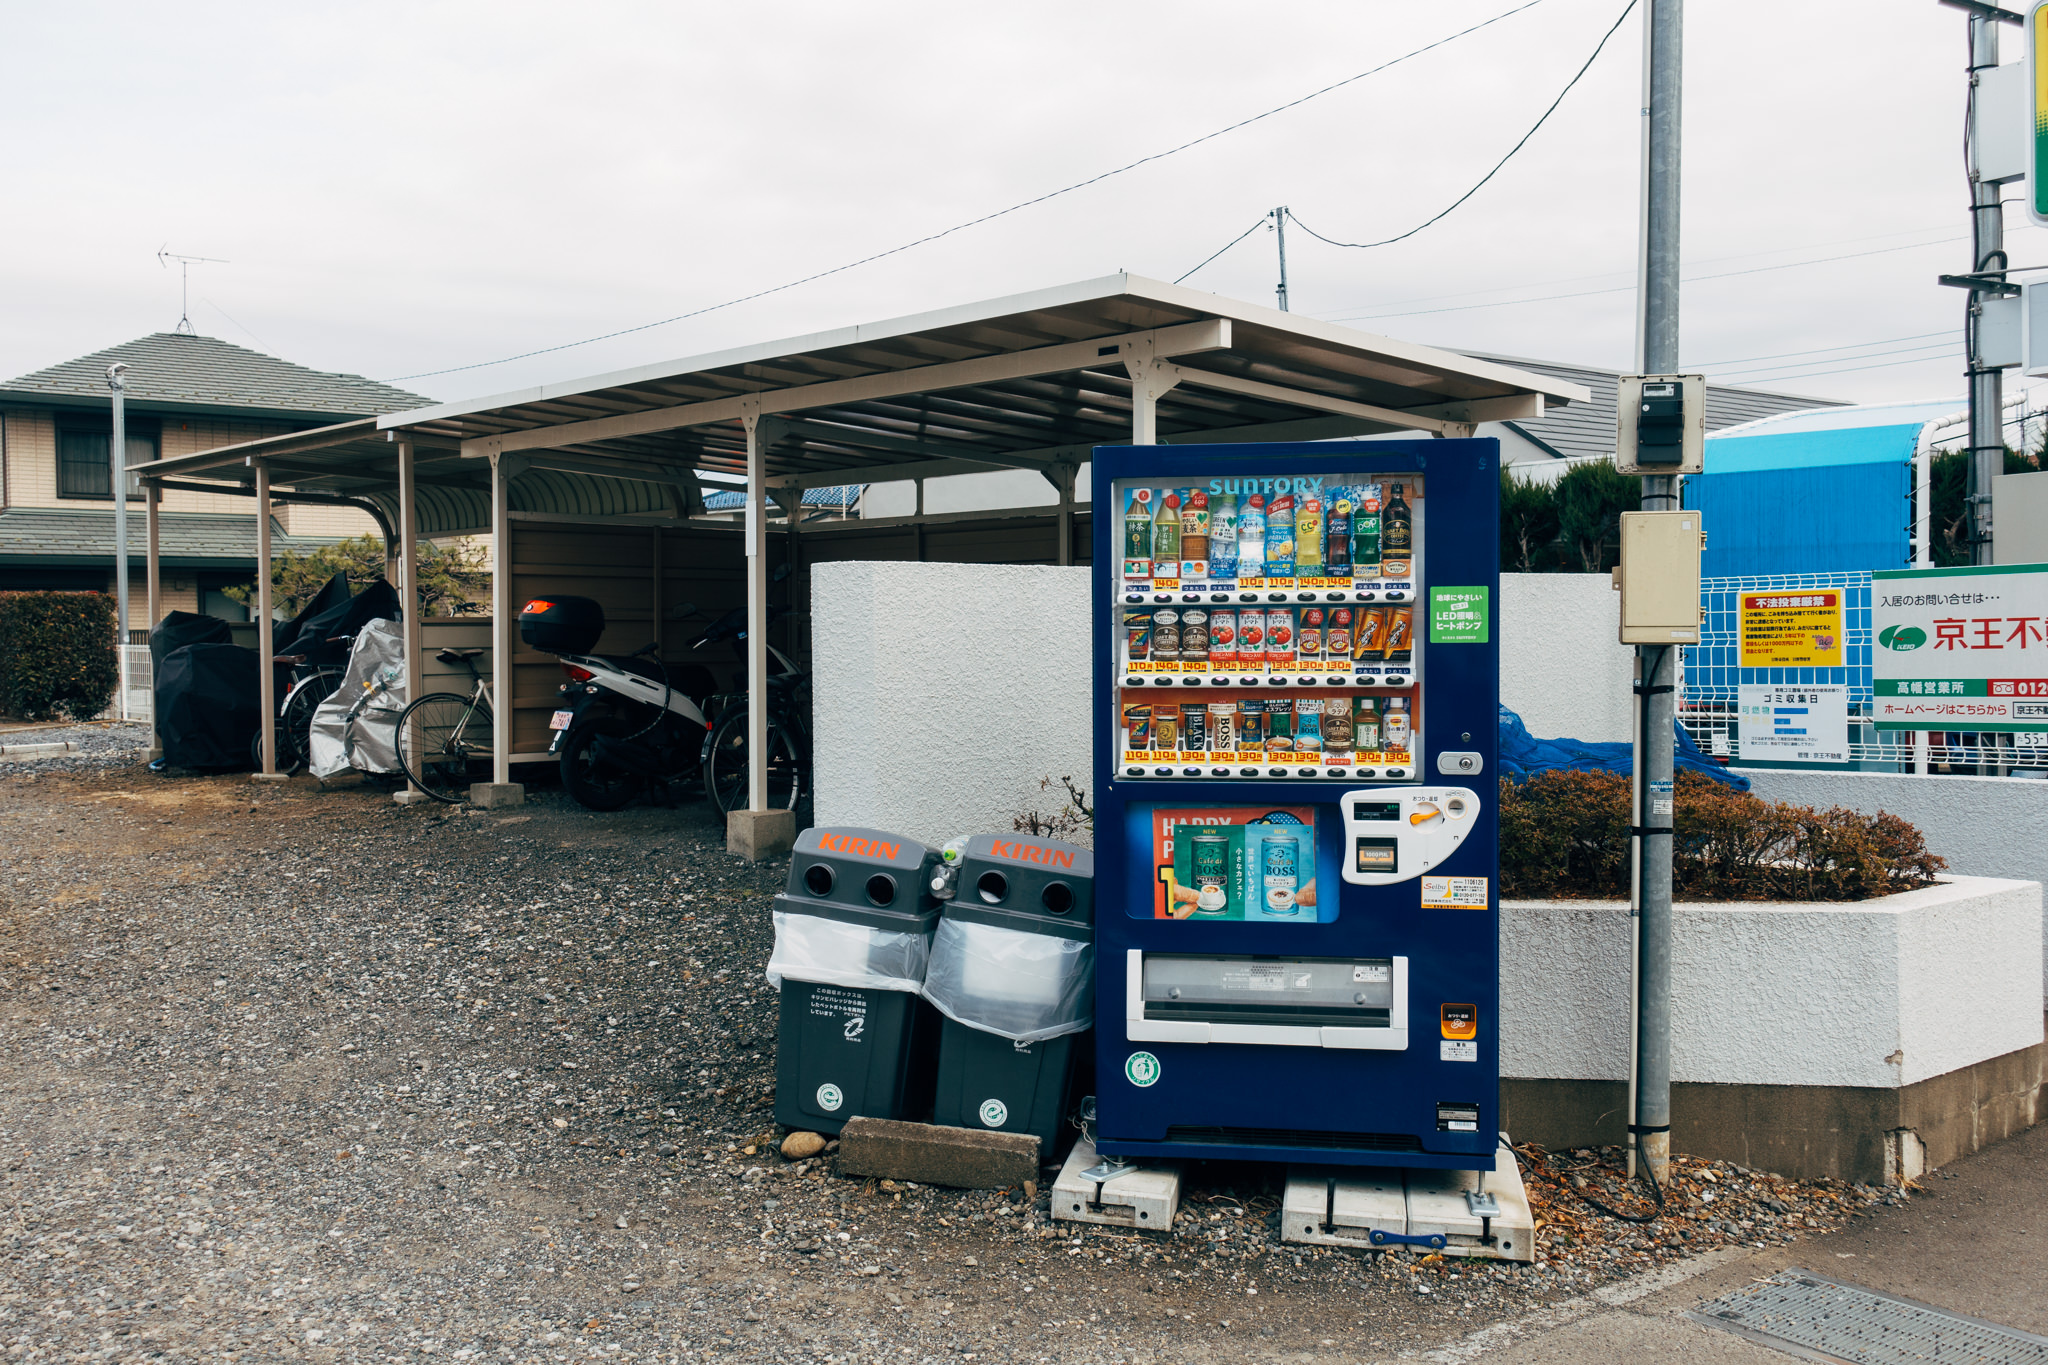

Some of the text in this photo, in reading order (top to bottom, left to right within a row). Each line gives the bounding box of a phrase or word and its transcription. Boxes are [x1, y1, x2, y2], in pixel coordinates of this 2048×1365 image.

[1209, 478, 1322, 495] SUNTORY
[1183, 524, 1197, 533] 麦茶
[1756, 596, 1825, 608] 不法投棄厳禁
[1436, 621, 1482, 630] ヒートポンプ
[1933, 617, 2048, 650] 京王不
[1897, 682, 1964, 694] 高幡営業所
[2018, 682, 2048, 694] 012
[1764, 694, 1818, 703] ゴミ収集日
[1742, 706, 1770, 714] 可燃物
[1884, 704, 2007, 716] ホームページはこちらから
[1193, 716, 1203, 749] BLACK
[1221, 718, 1230, 749] BOSS
[818, 833, 900, 860] KIRIN
[991, 840, 1075, 868] KIRIN
[1196, 865, 1225, 875] BOSS
[1266, 866, 1295, 876] BOSS
